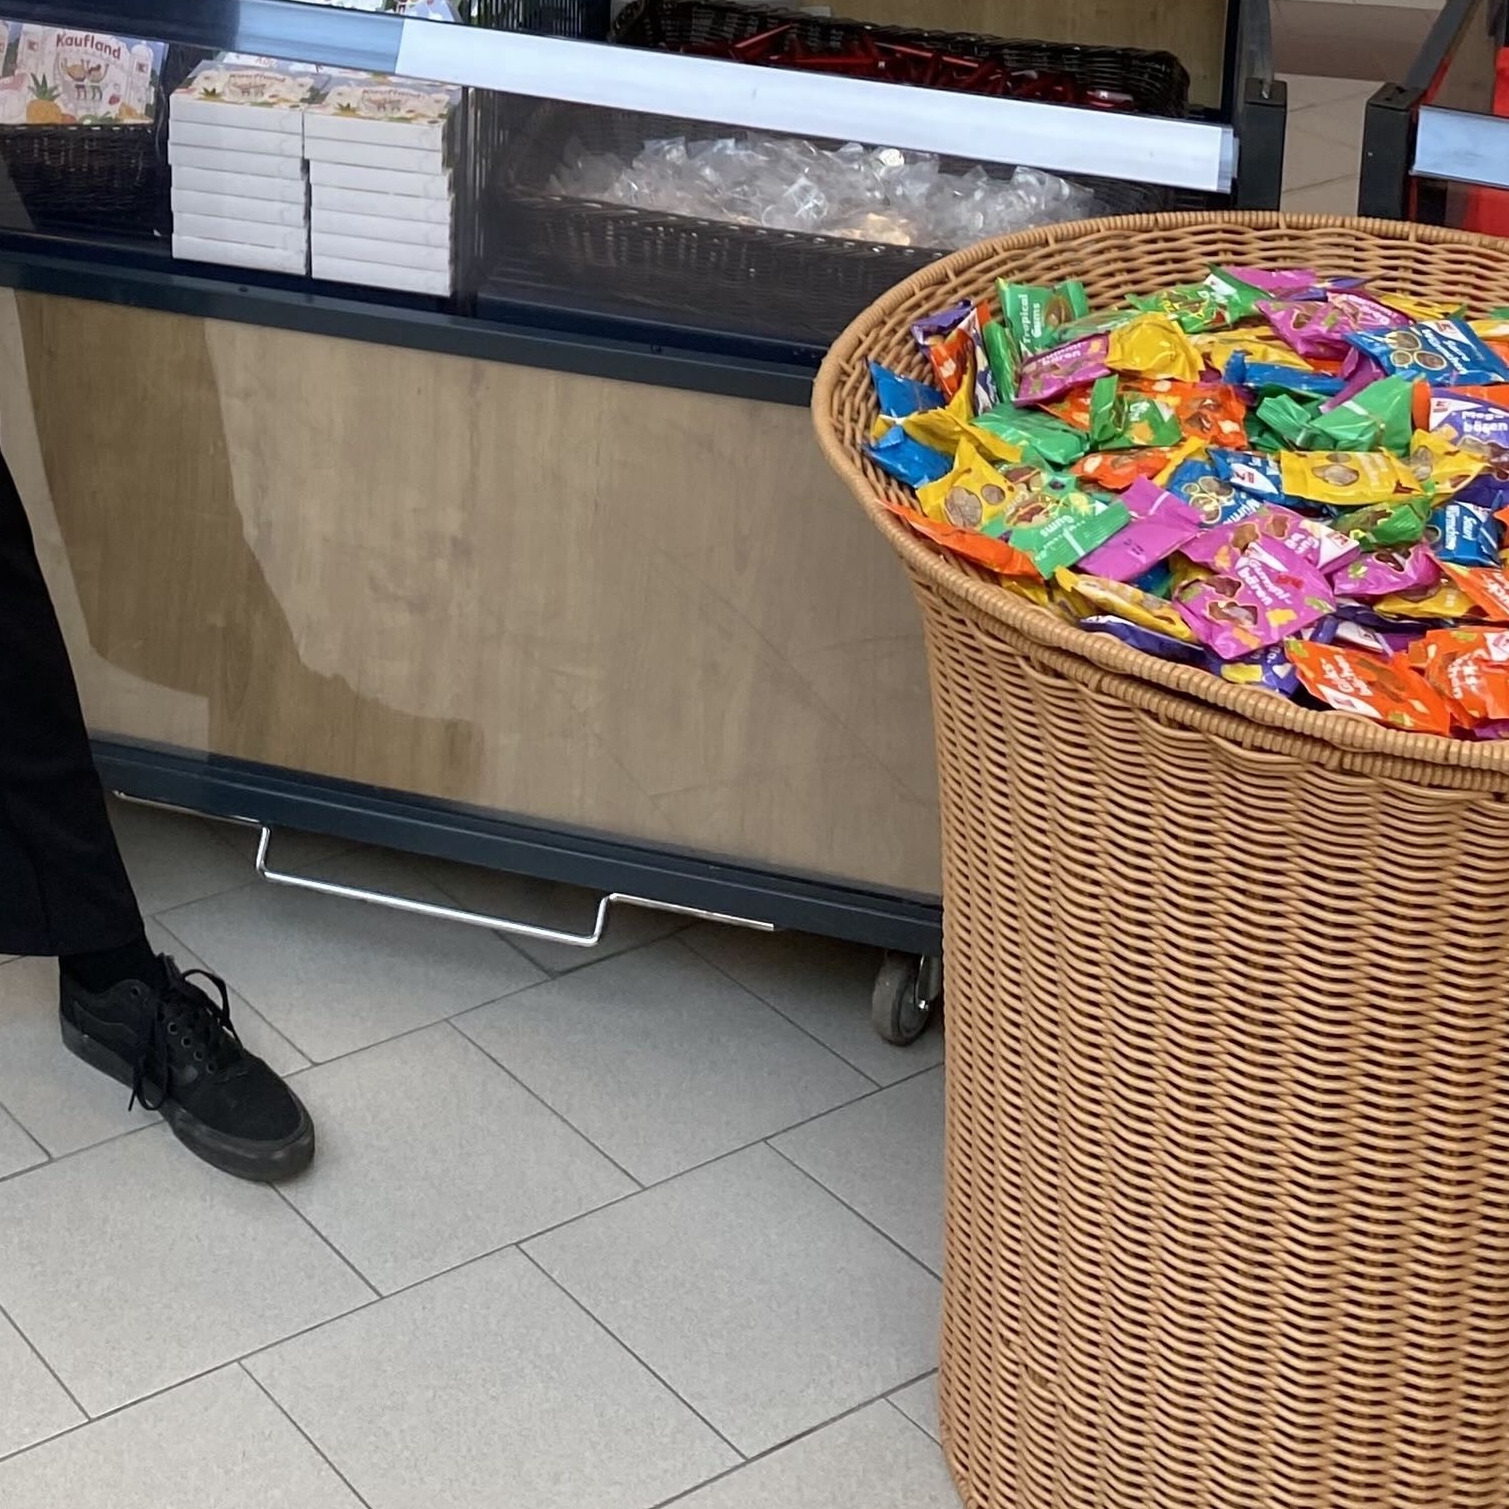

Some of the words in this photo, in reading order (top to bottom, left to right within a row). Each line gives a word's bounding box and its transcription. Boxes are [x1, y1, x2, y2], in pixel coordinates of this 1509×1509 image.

[56, 33, 122, 60] Kaufland
[1017, 293, 1031, 343] Tropical
[1030, 302, 1043, 338] Gums
